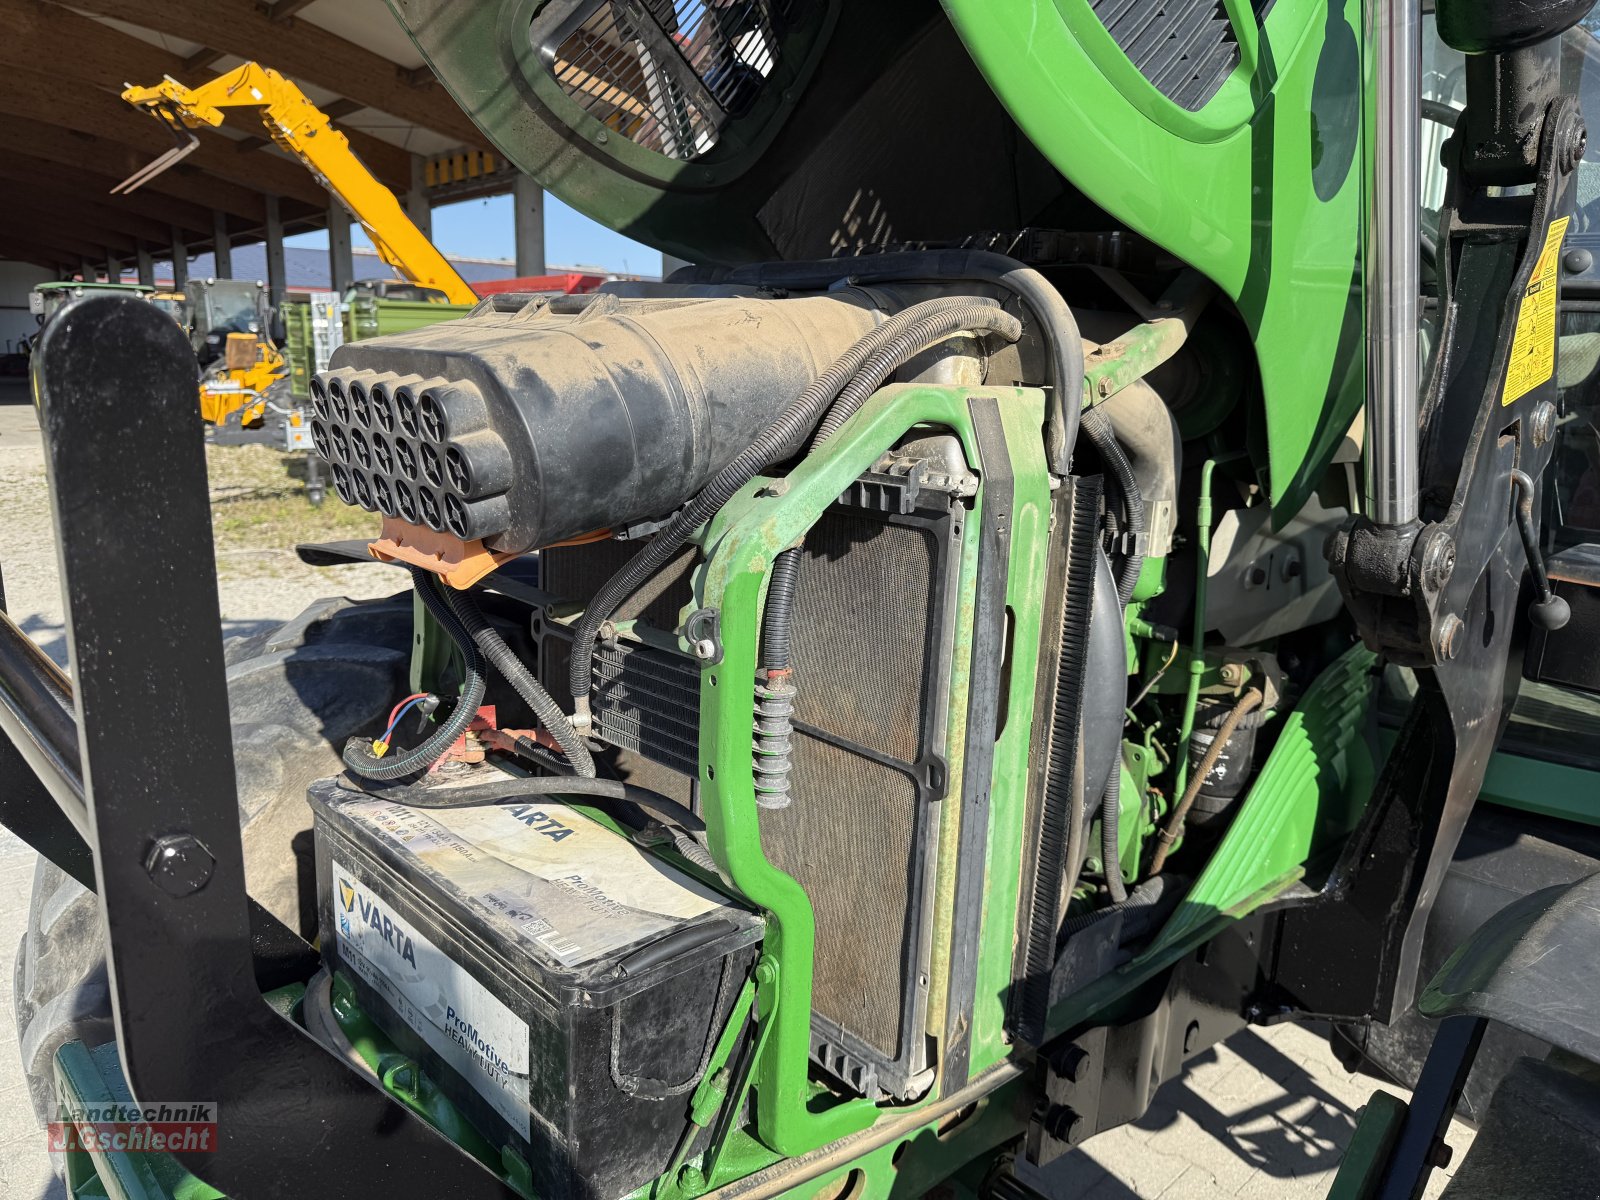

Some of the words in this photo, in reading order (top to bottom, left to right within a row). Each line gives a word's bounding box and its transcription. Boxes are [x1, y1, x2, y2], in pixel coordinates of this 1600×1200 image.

[501, 804, 575, 842] ARTA
[564, 874, 632, 917] ProMotive
[358, 893, 416, 970] VARTA
[444, 1023, 478, 1060] HEAVY
[480, 1058, 508, 1089] DUTY
[446, 1005, 509, 1075] ProMotive
